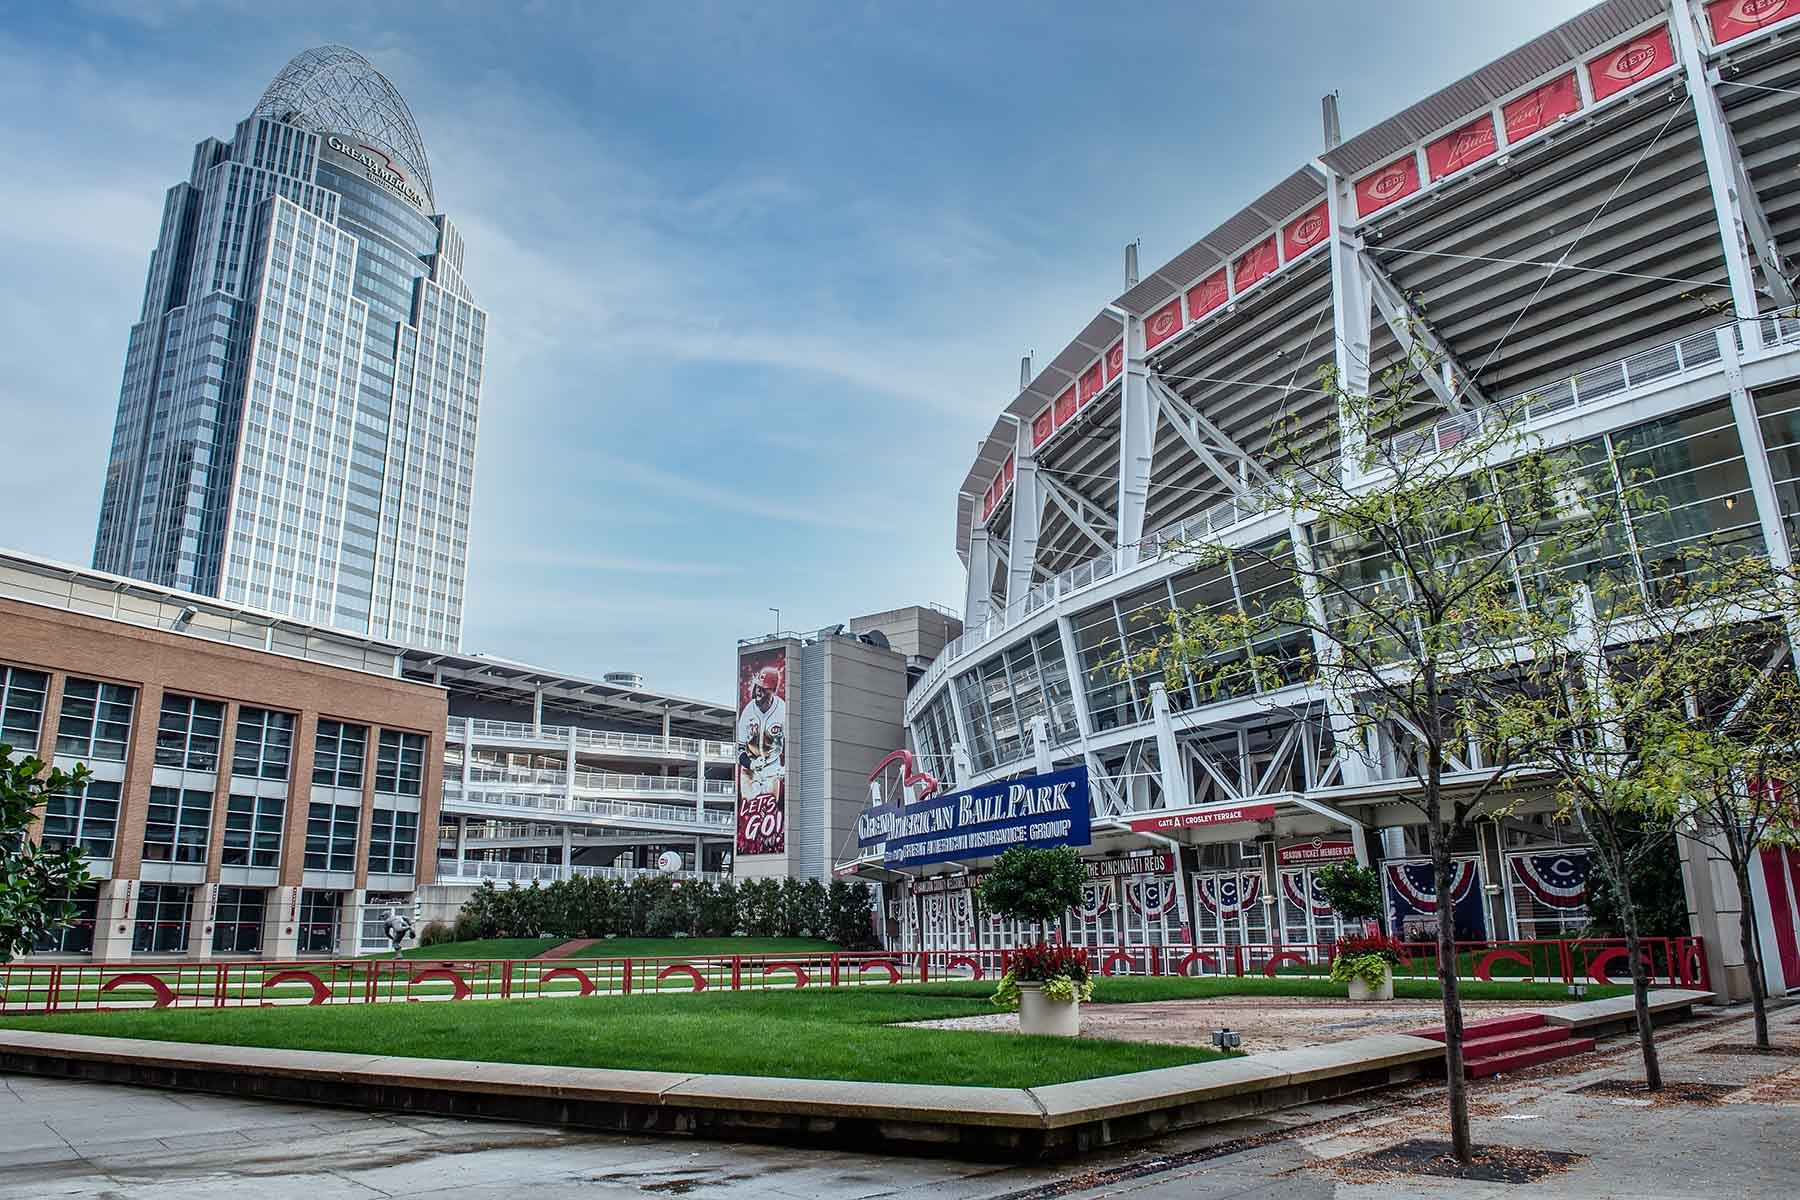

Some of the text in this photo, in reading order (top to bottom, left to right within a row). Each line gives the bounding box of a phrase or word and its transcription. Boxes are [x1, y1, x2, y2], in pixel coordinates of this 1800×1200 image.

[1618, 47, 1656, 71] REDS
[328, 136, 375, 168] GREAT
[369, 163, 424, 207] AMERICAN
[1377, 174, 1406, 193] REDS
[740, 794, 776, 816] LET'S
[745, 811, 782, 843] GO!
[1029, 819, 1072, 841] GROUP
[1158, 811, 1242, 828] GATE A CROSLEY TERRACE
[1282, 850, 1302, 860] SEASON
[1302, 849, 1319, 858] TICKET
[1320, 847, 1343, 857] MEMBER
[1101, 857, 1142, 876] CINCINNATI
[1144, 855, 1165, 872] REDS
